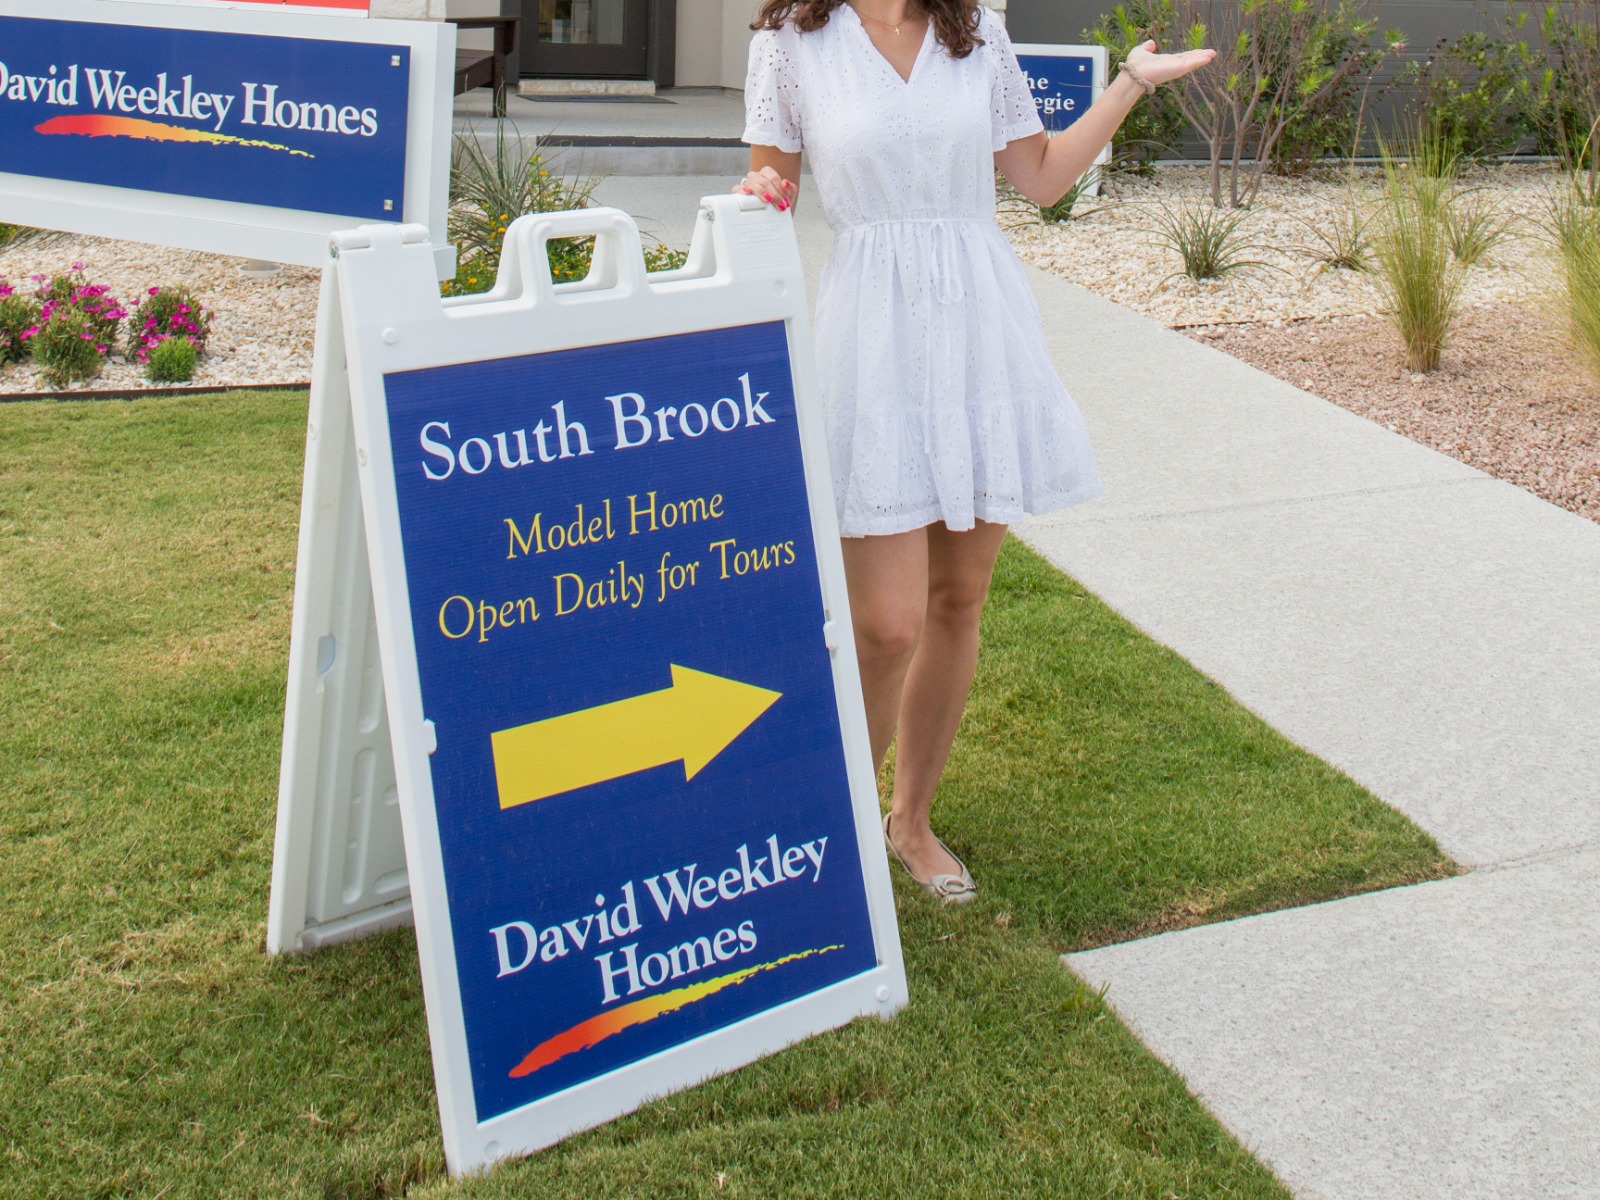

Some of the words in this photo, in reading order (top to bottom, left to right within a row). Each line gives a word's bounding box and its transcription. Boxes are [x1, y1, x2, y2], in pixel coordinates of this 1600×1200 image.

[83, 68, 235, 132] Weekley
[241, 81, 378, 137] Homes
[1022, 70, 1049, 90] he
[1033, 92, 1075, 115] egie
[419, 400, 595, 481] South
[604, 372, 776, 450] Brook
[503, 498, 616, 560] Model
[627, 491, 724, 535] Home
[438, 595, 540, 643] Open
[553, 560, 645, 617] Daily
[656, 551, 700, 603] for
[709, 538, 796, 580] Tours
[489, 881, 642, 978] David
[643, 833, 829, 922] Weekley
[594, 919, 758, 1005] Homes
